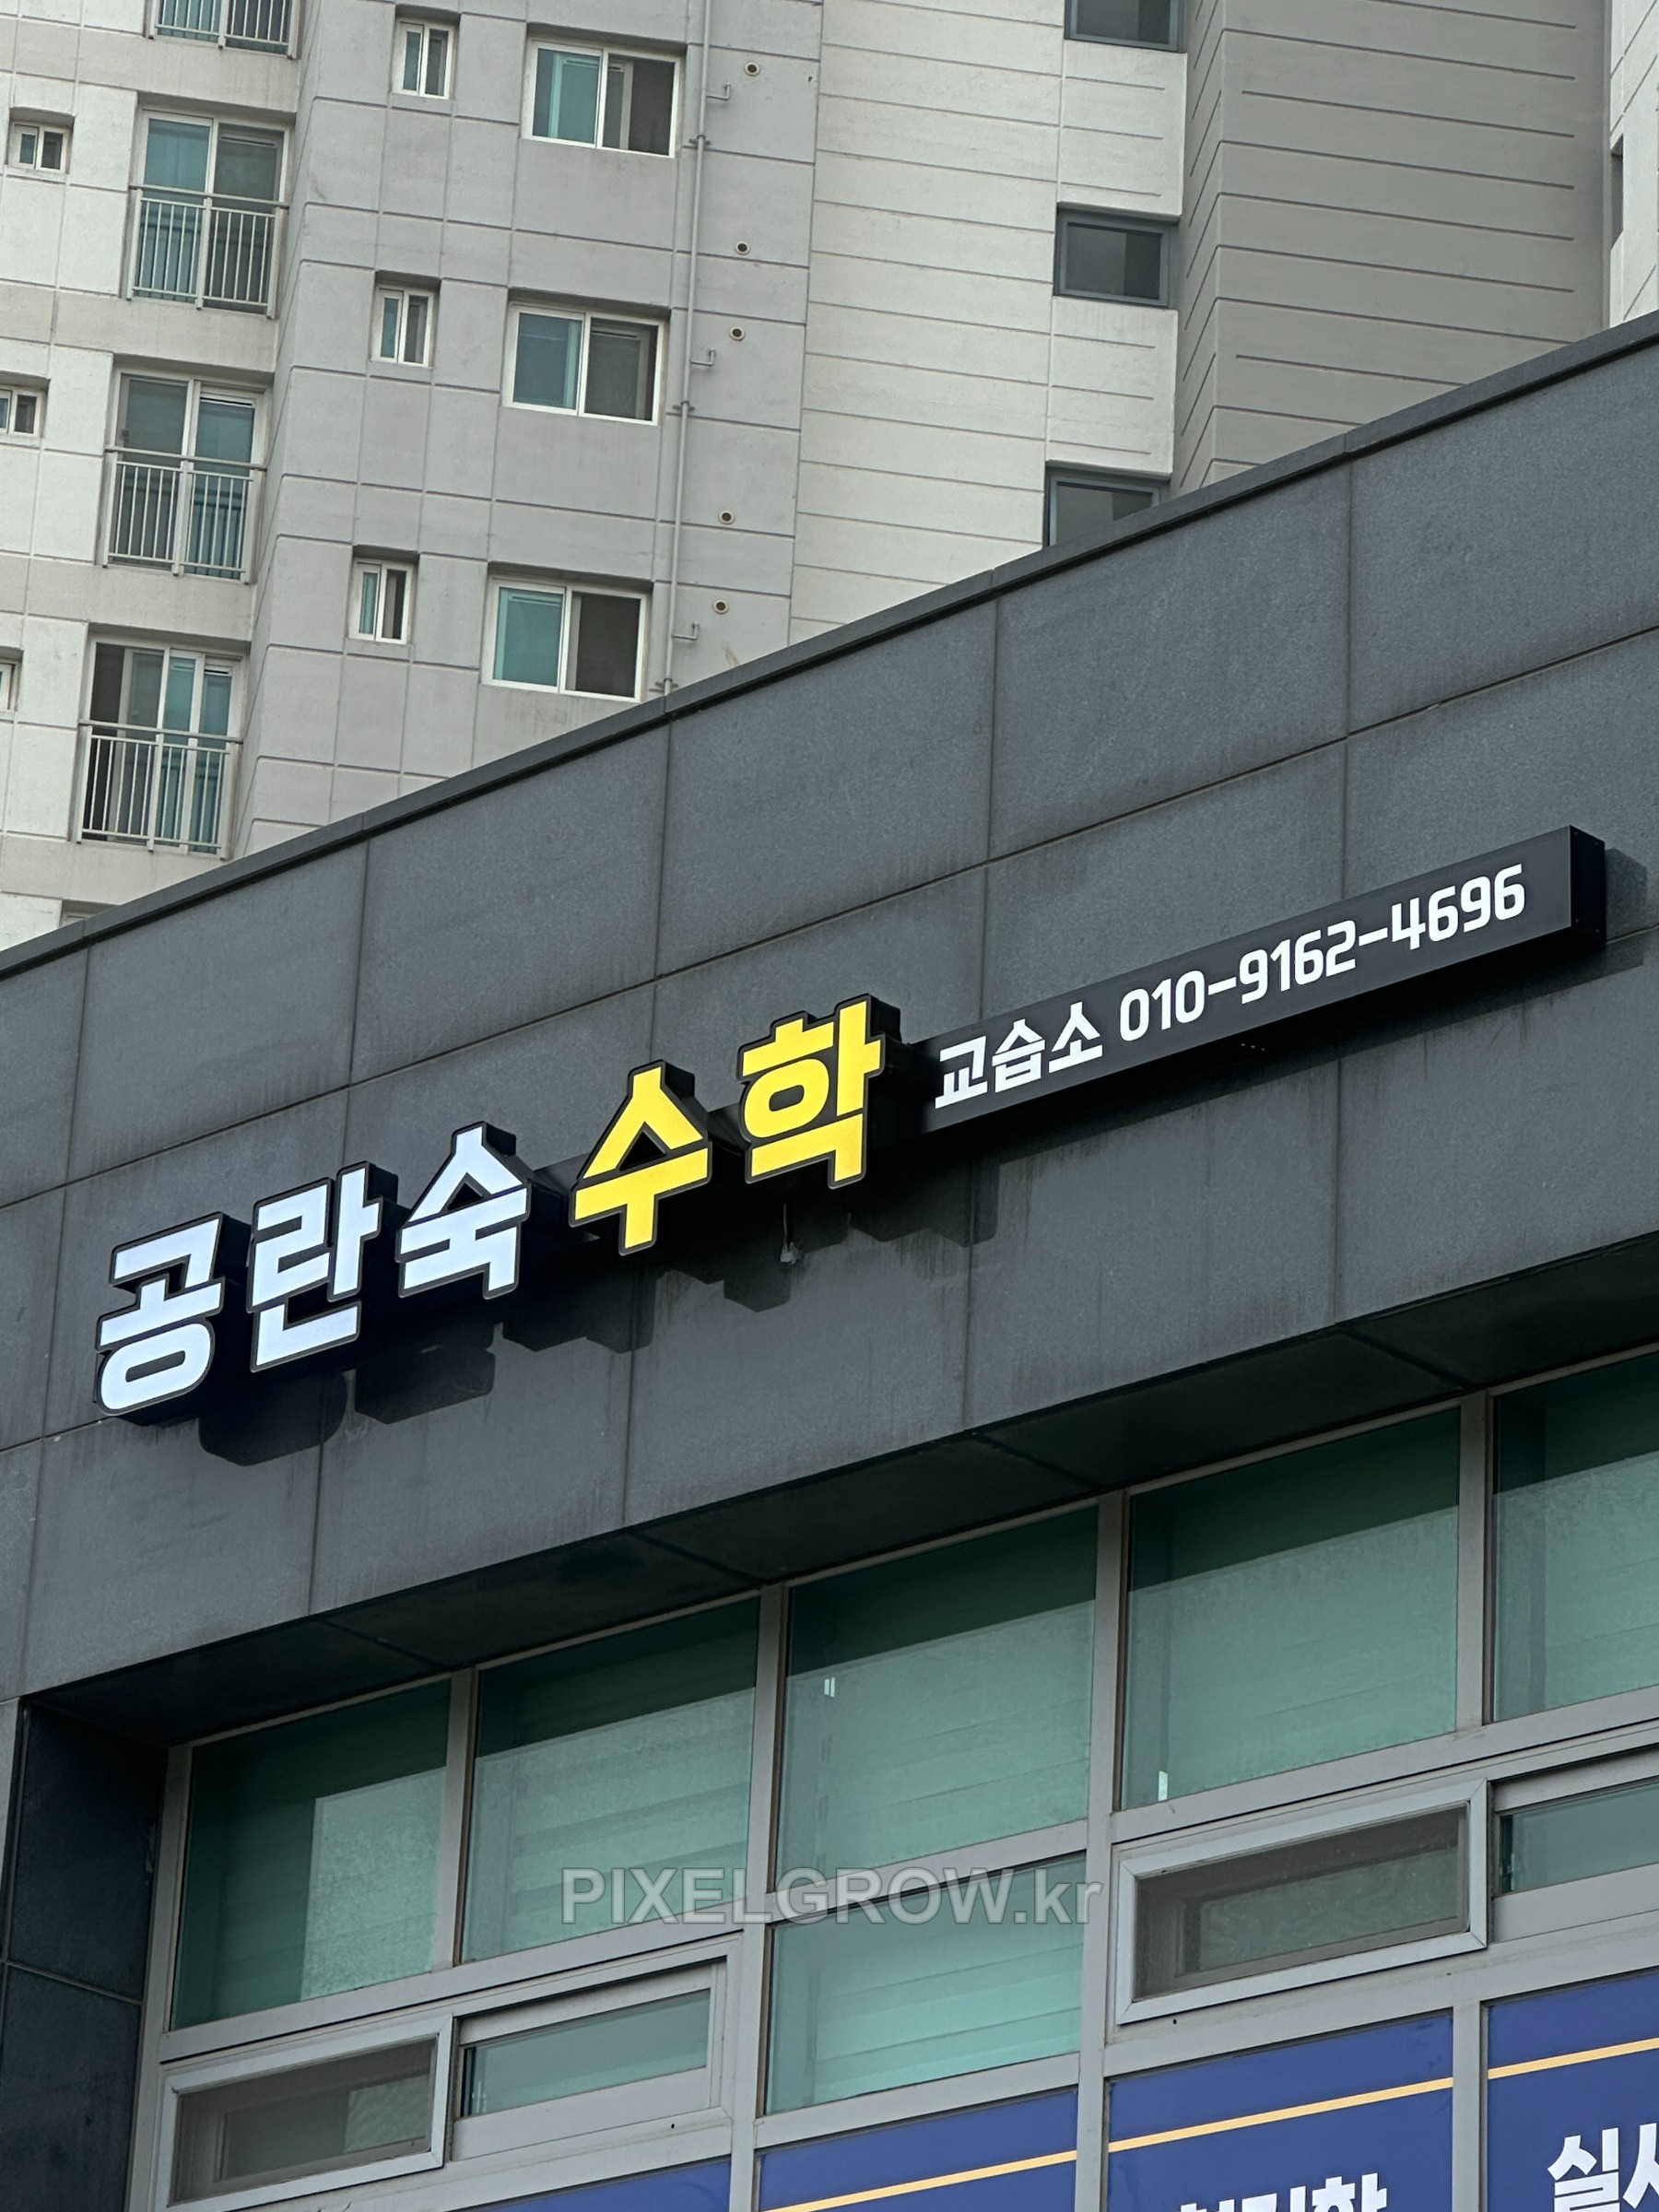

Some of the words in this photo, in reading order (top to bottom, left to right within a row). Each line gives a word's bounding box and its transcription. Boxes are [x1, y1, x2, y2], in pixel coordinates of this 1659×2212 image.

[935, 1001, 1103, 1109] 교습소
[1119, 864, 1526, 1042] 010-9162-4696
[99, 1126, 528, 1411] 공란숙
[574, 1001, 882, 1248] 수학
